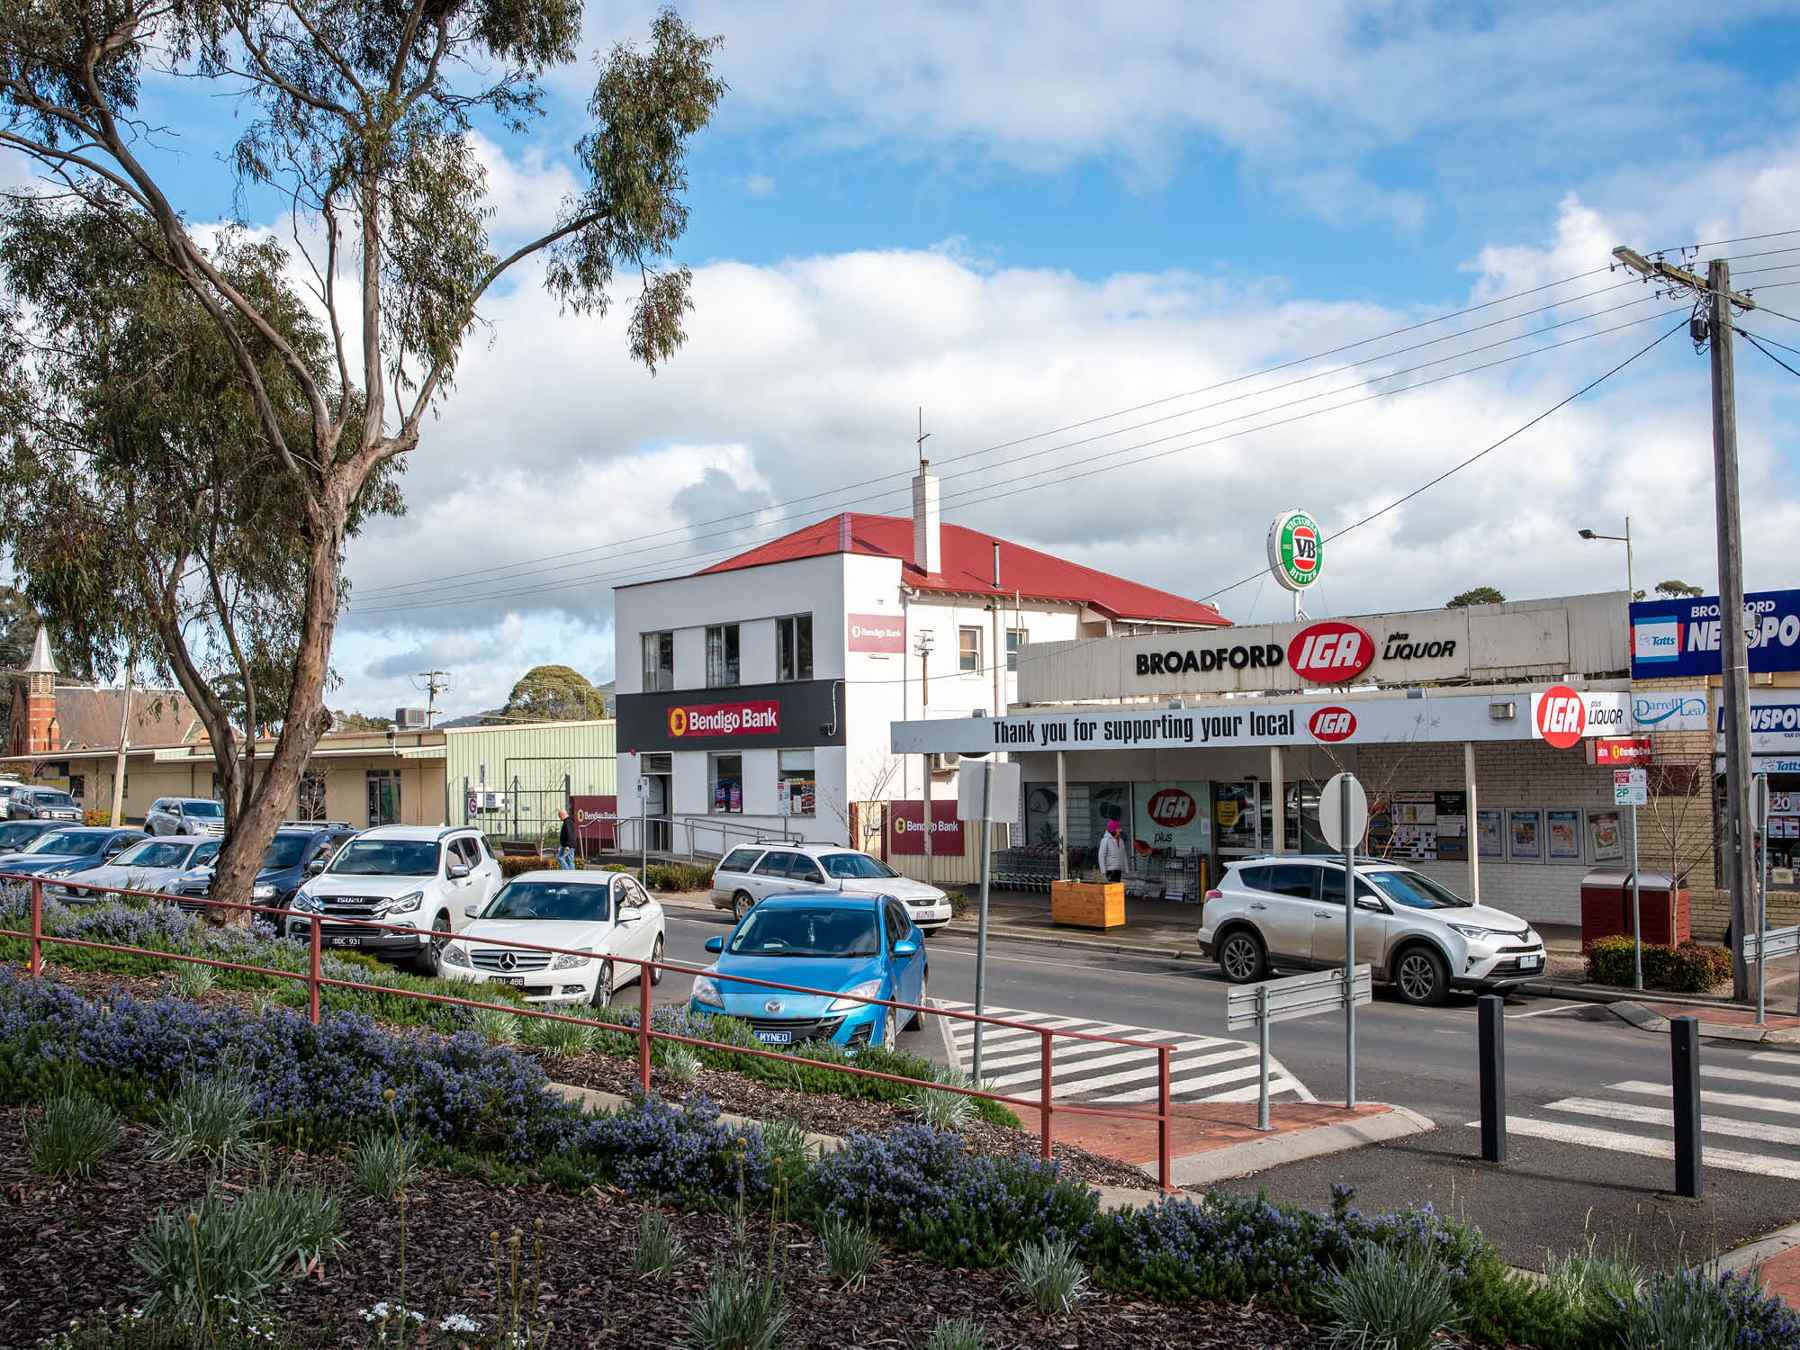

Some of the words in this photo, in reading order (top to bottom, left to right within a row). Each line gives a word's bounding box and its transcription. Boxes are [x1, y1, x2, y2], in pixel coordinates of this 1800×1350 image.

[1295, 538, 1316, 559] VB
[1691, 600, 1776, 619] BROORD
[1388, 632, 1409, 643] plus
[1652, 635, 1675, 646] Tatts
[1136, 644, 1284, 676] BROADFORD
[1296, 632, 1361, 670] IGA
[1382, 640, 1456, 660] LIQUOR
[1542, 697, 1580, 734] IGA
[1588, 708, 1623, 725] LIQUOR
[1633, 698, 1679, 723] Darrell
[689, 710, 740, 733] Bendigo
[742, 708, 777, 728] Bank
[993, 720, 1035, 744] Thank
[1041, 722, 1067, 746] you
[1074, 718, 1097, 741] for
[1104, 714, 1194, 744] supporting
[1200, 716, 1243, 742] your
[1249, 709, 1295, 736] local
[1314, 713, 1352, 734] IGA
[1776, 760, 1800, 771] Tatts
[1616, 788, 1630, 798] 2P
[1153, 796, 1190, 817] IGA
[938, 820, 959, 832] Bank
[1154, 832, 1174, 844] plus
